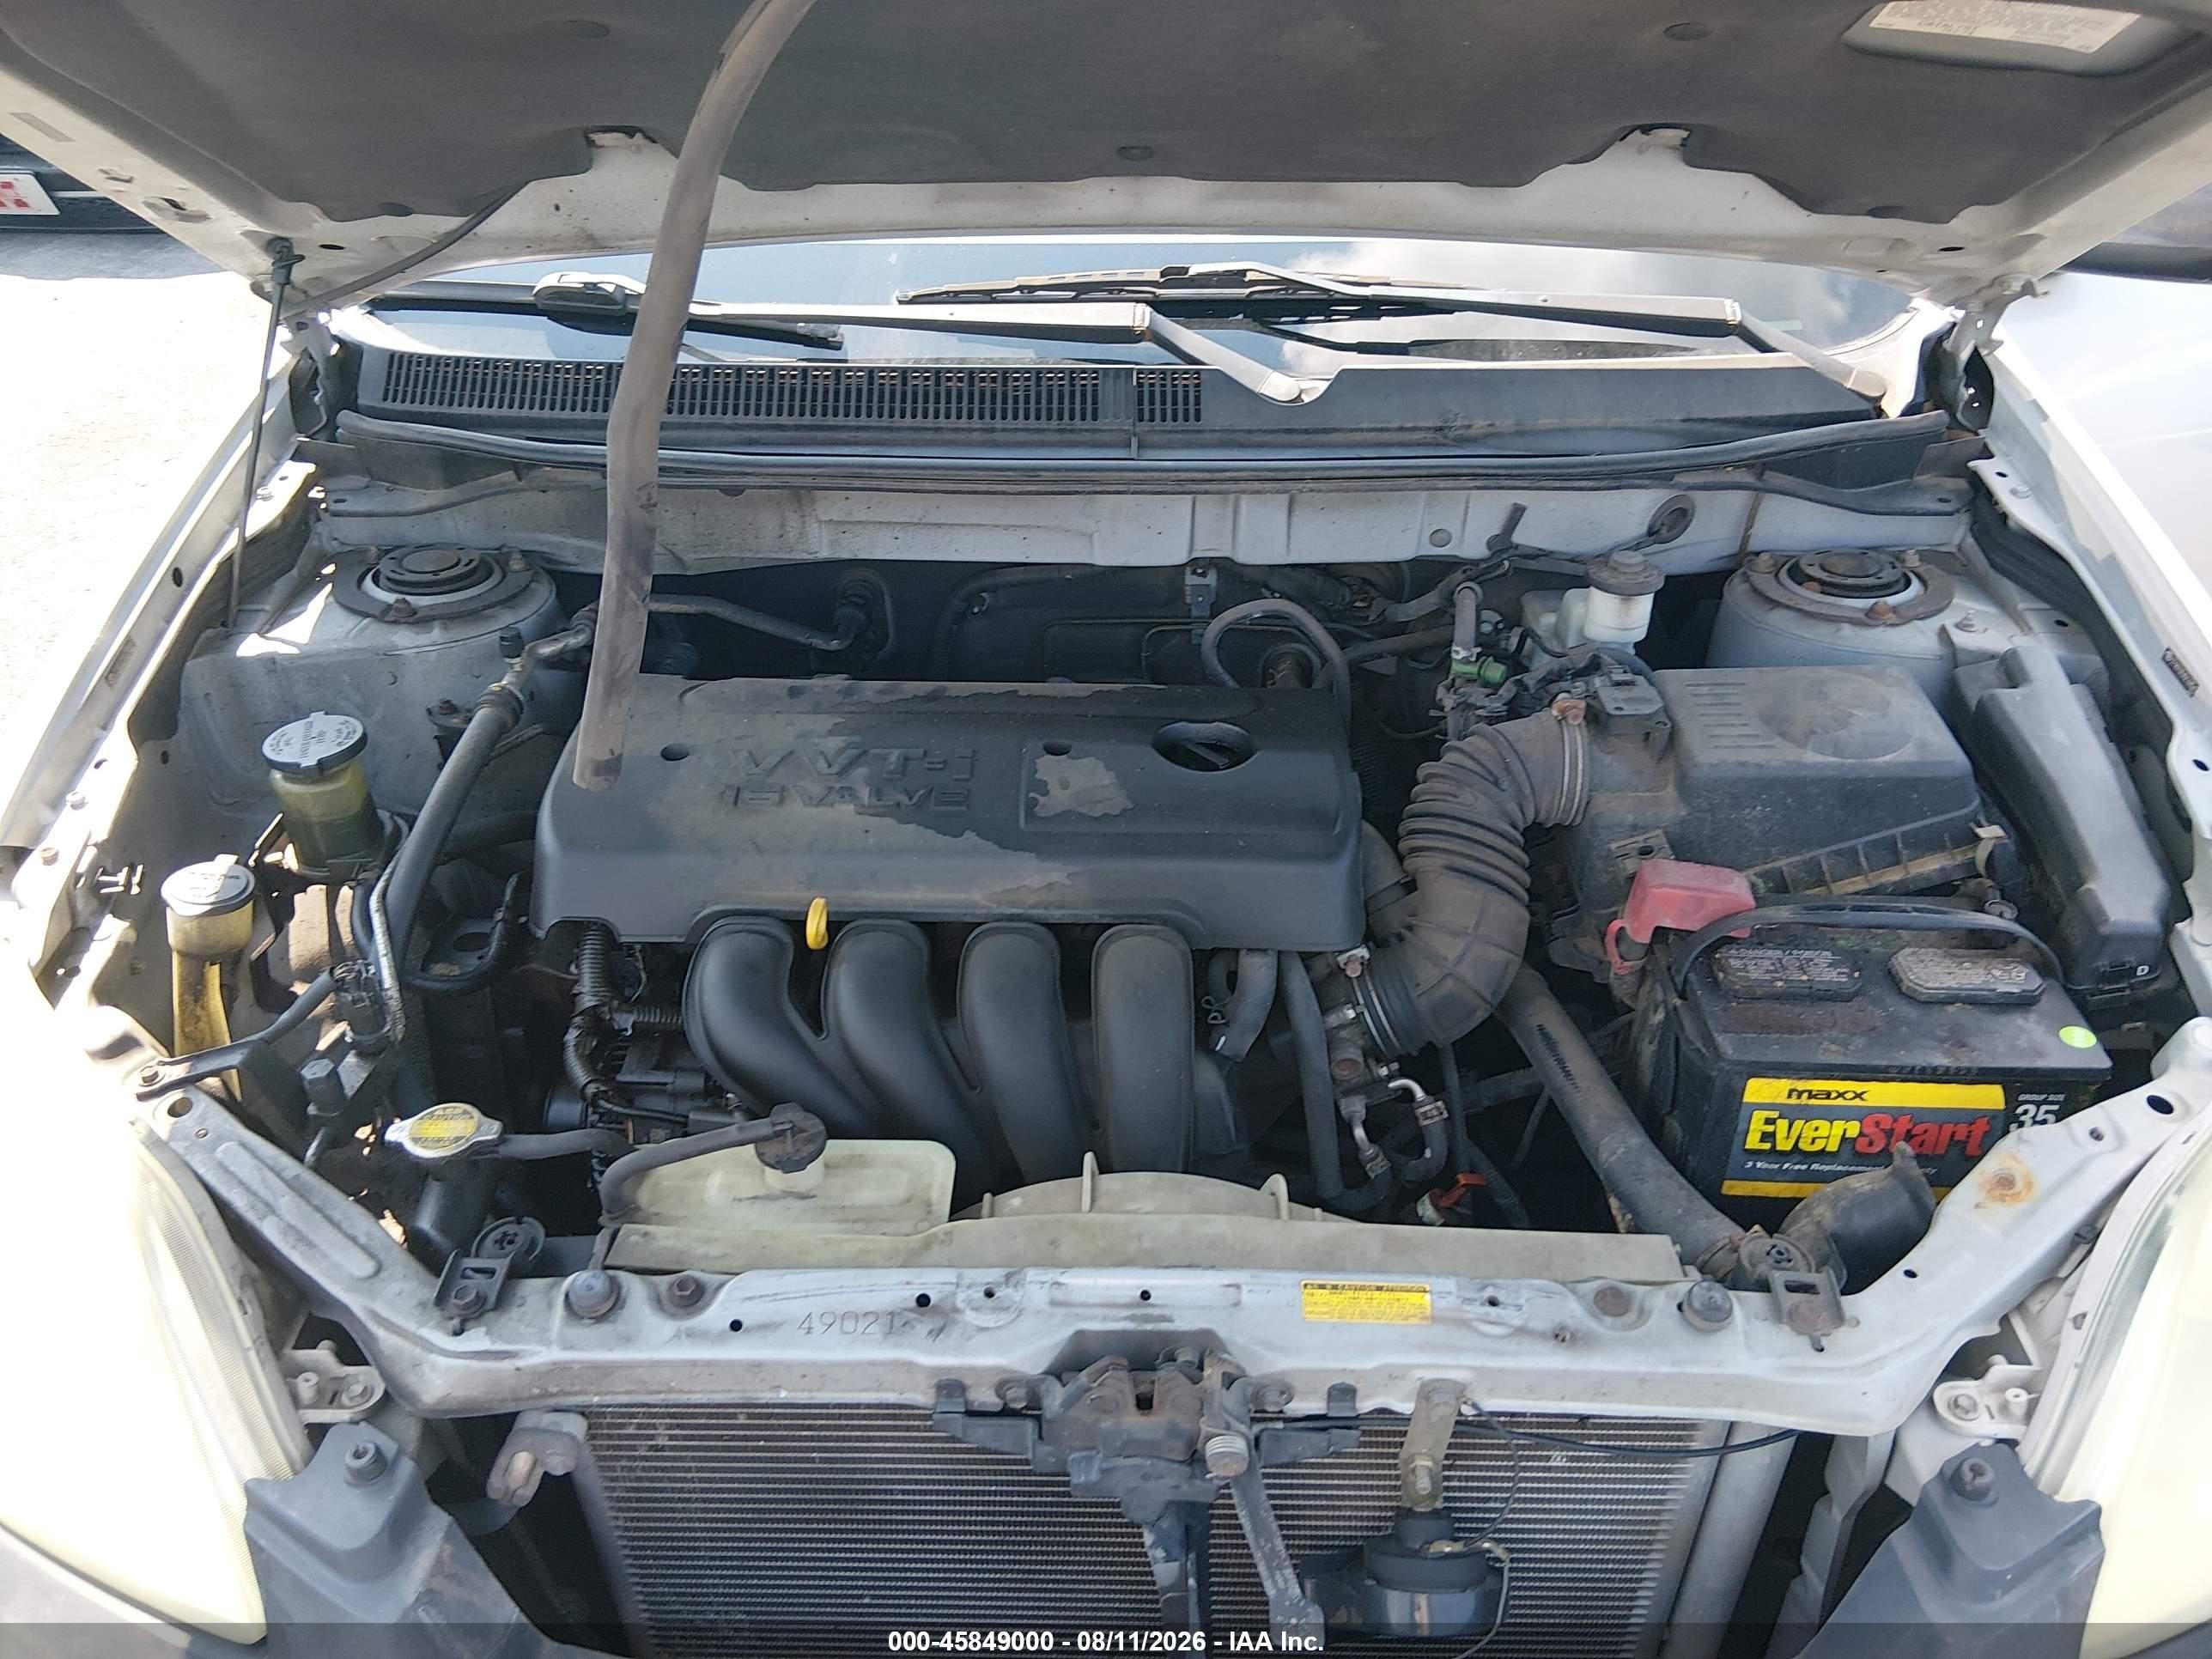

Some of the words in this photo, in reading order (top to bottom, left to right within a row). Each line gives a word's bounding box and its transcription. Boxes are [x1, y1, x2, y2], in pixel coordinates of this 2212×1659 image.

[1786, 1087, 1871, 1102] maxx
[2008, 1103, 2061, 1132] 35
[1744, 1109, 1990, 1156] EverStart
